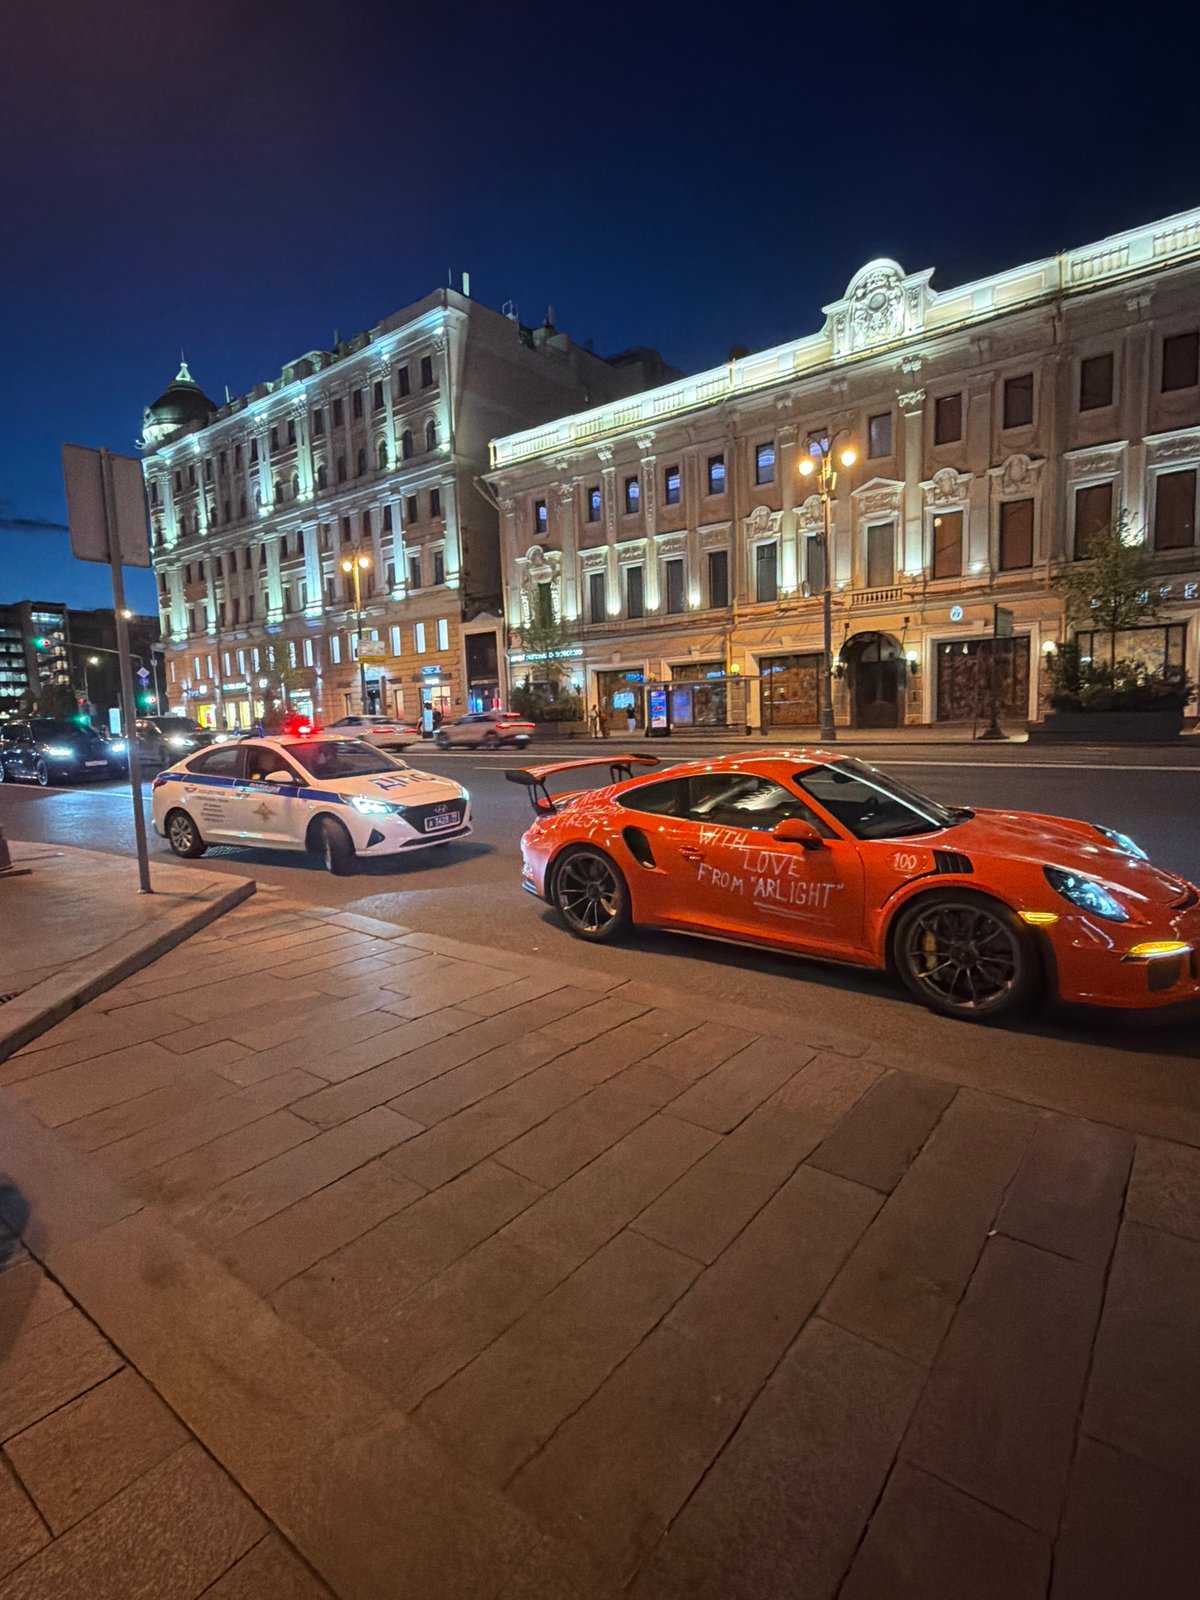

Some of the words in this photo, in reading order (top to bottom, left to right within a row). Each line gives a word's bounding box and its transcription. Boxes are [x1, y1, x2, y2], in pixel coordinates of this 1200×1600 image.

[368, 774, 436, 791] ДПС
[698, 825, 749, 850] WITH
[743, 850, 802, 878] LOVE
[892, 852, 918, 871] 100
[697, 862, 745, 896] FROM
